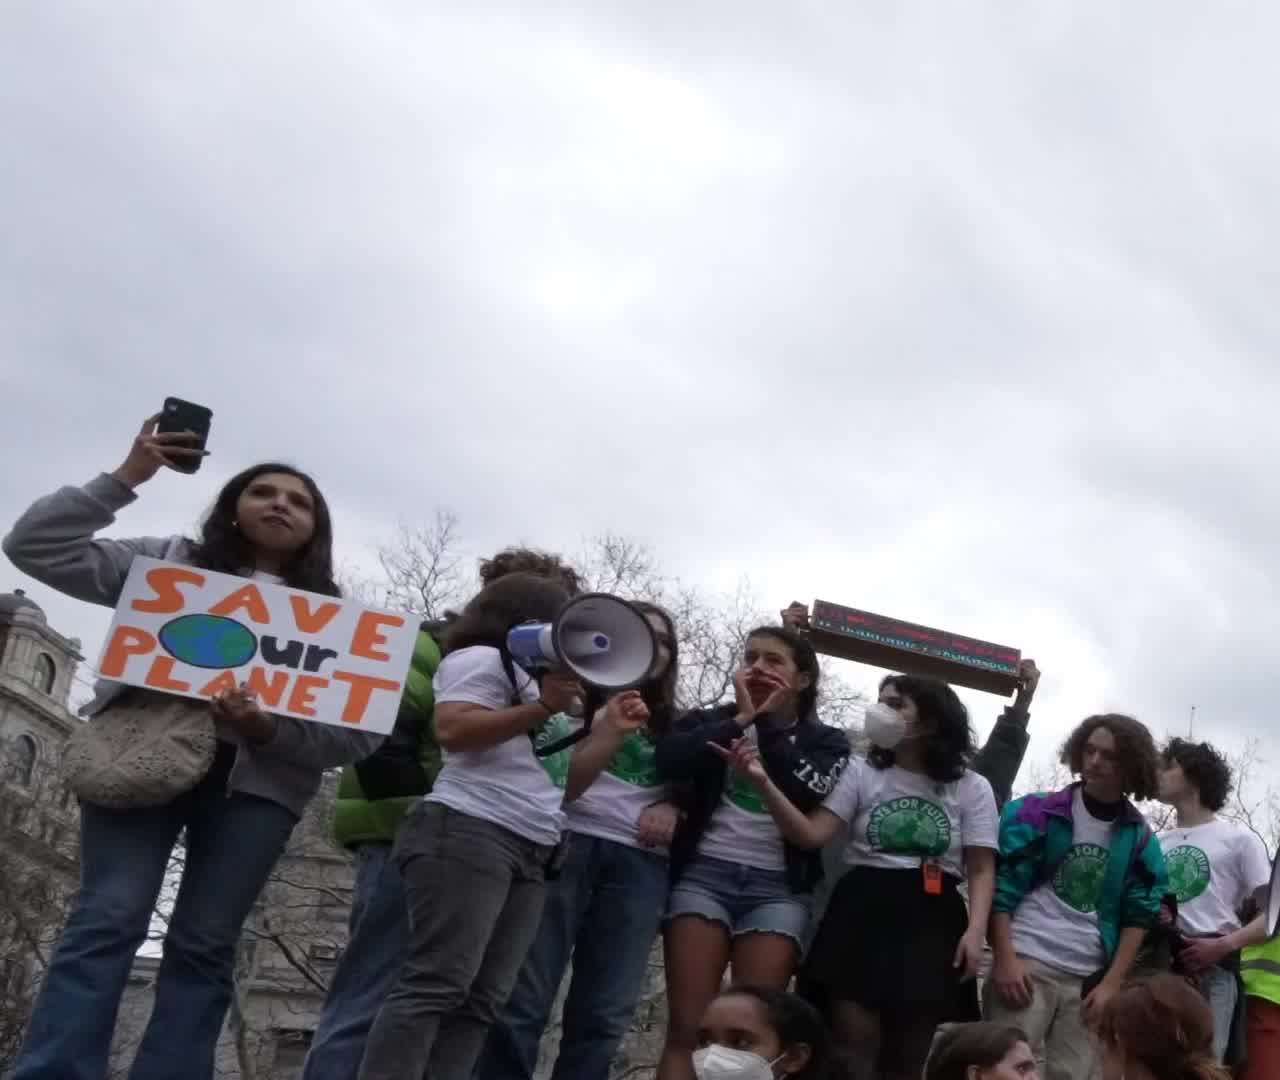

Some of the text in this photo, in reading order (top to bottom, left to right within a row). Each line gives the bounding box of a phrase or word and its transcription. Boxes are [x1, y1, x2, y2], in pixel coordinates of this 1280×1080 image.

[131, 567, 404, 662] SAVE
[100, 625, 400, 724] PLANET
[893, 798, 920, 811] FOR
[919, 803, 952, 843] FUTURE
